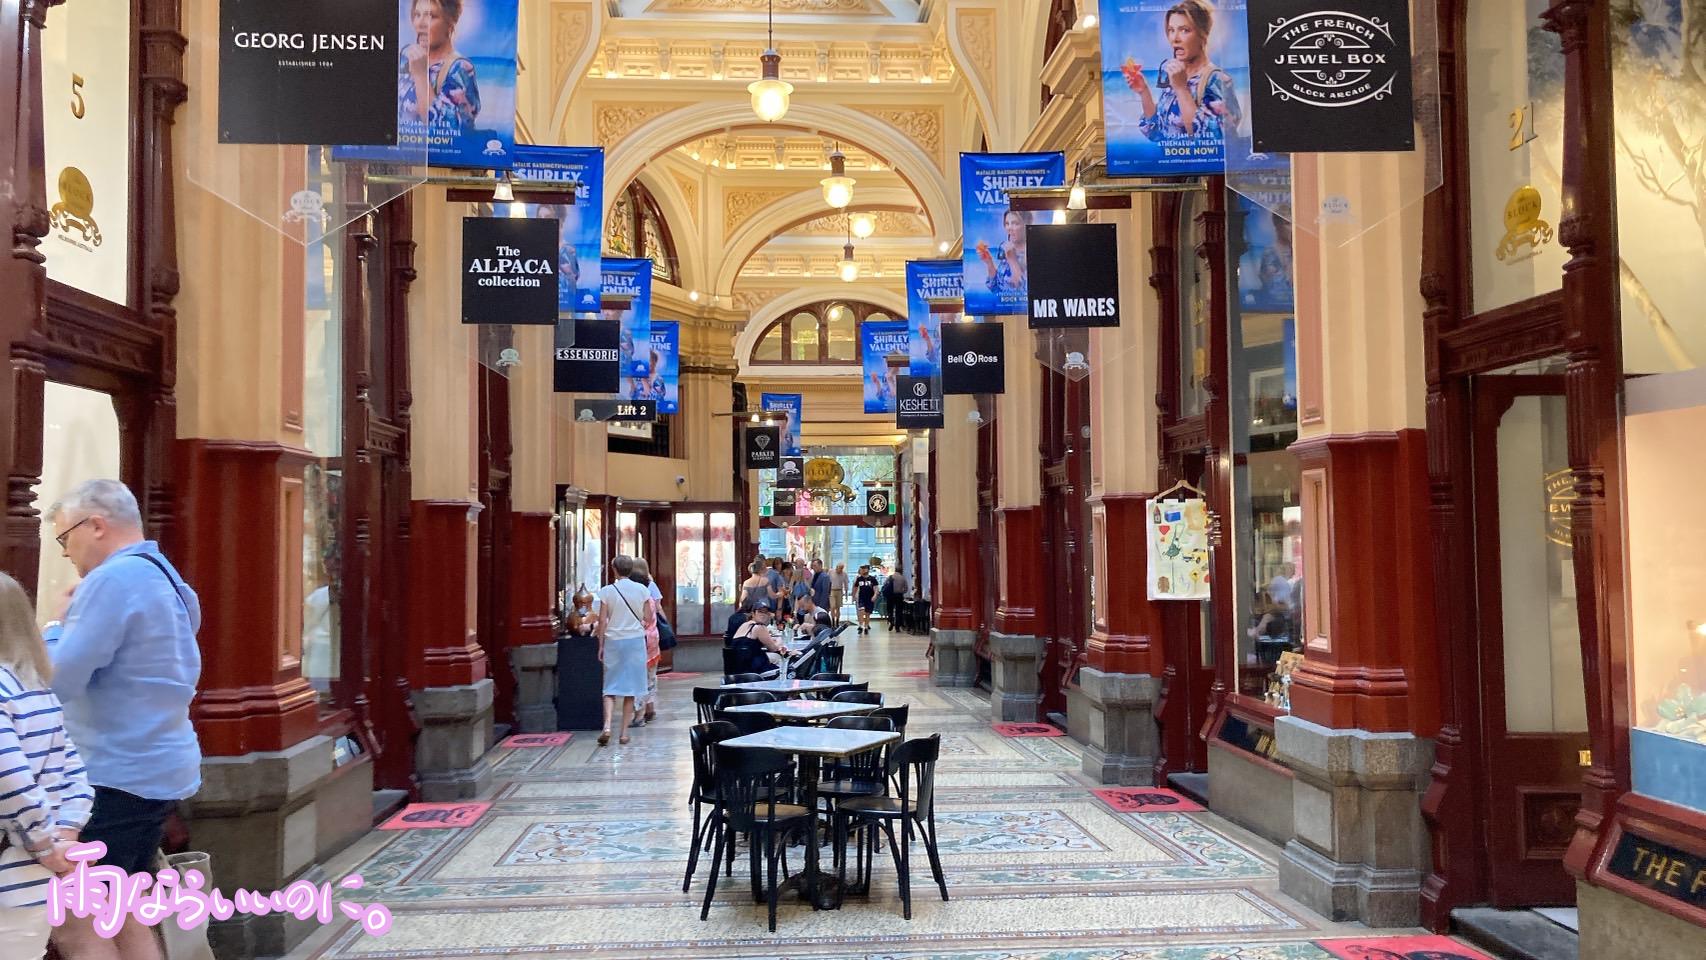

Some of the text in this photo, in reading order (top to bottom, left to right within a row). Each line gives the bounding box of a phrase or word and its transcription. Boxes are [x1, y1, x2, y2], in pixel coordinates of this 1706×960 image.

[1281, 19, 1376, 41] THE FRENCH
[234, 32, 385, 52] GEORG JENSEN
[1275, 53, 1387, 65] JEWEL BOX
[70, 72, 85, 119] 5
[1293, 83, 1371, 98] BLOCK ARCADE
[1508, 101, 1538, 151] 21
[426, 136, 453, 146] NOW!
[1164, 146, 1218, 156] BOOK NOW!
[983, 175, 1044, 191] SHIRLEY
[496, 246, 521, 256] The
[468, 259, 553, 274] ALPACA
[478, 276, 541, 287] collection
[1033, 297, 1116, 318] MR WARES
[873, 334, 908, 344] SHIRLEY
[557, 349, 618, 361] ESSENSORIE
[947, 354, 963, 364] Bell
[978, 354, 998, 363] Ross
[617, 404, 647, 416] Lift 2
[899, 398, 940, 411] KESHETT
[1633, 847, 1686, 887] THE
